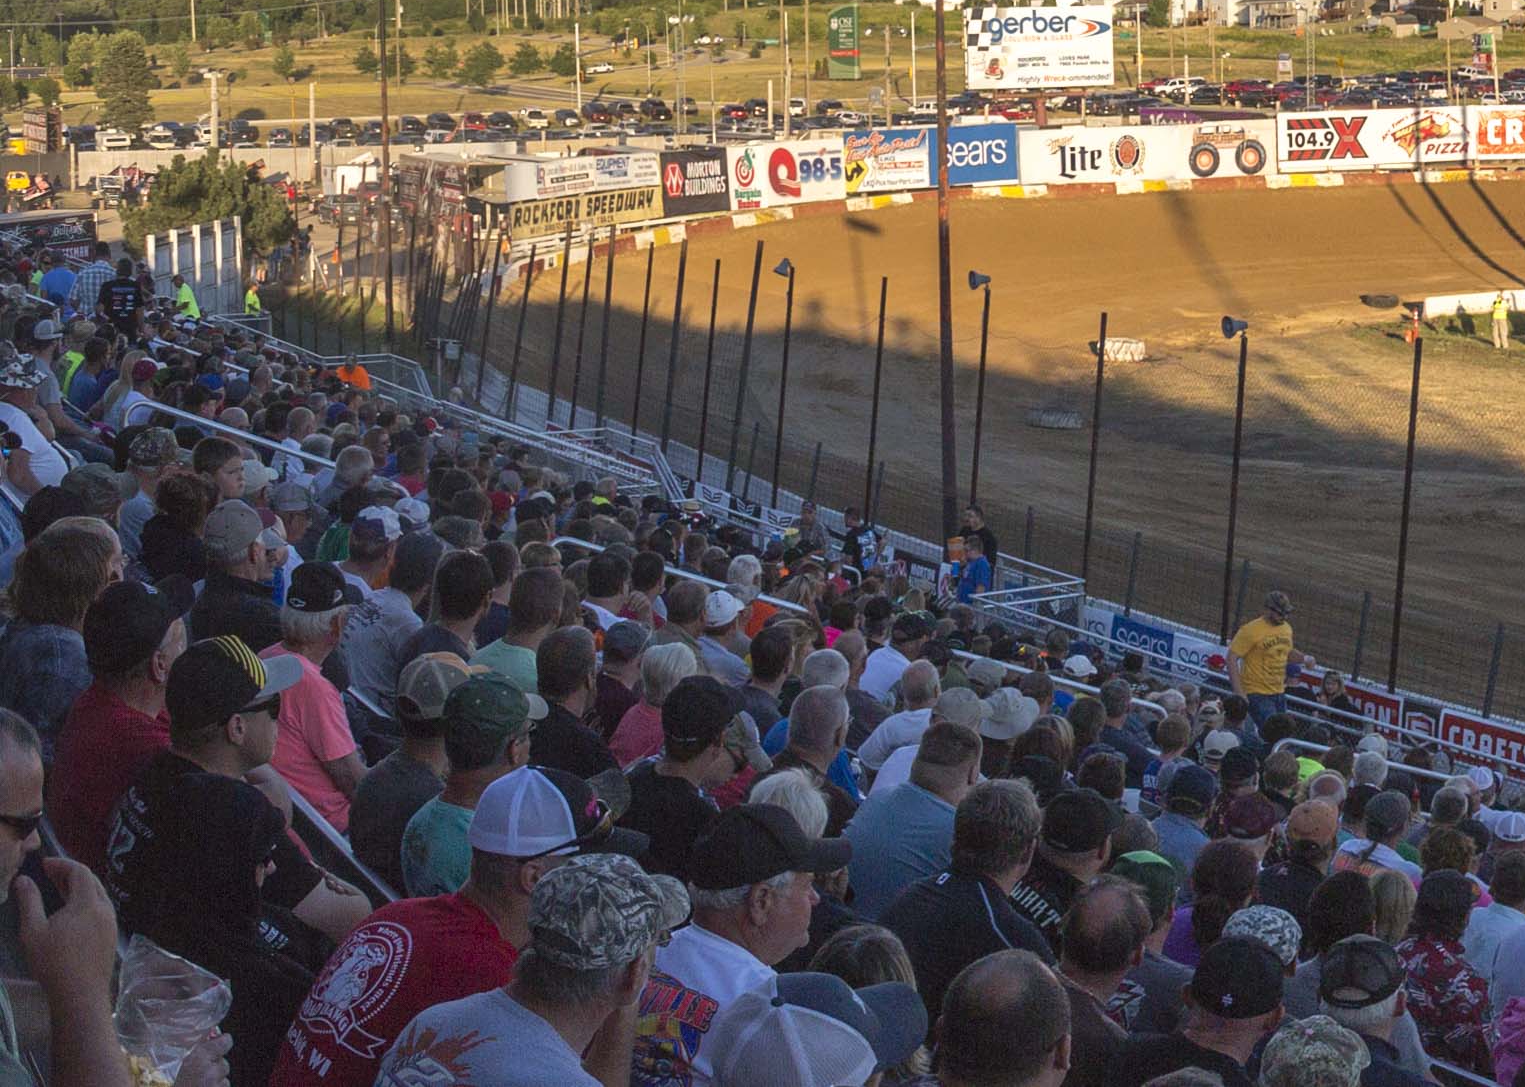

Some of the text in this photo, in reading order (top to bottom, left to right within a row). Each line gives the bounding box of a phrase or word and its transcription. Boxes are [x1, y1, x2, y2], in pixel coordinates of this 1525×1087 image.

[988, 9, 1077, 42] gerber
[1017, 75, 1041, 85] Highly
[1286, 132, 1334, 148] 104.9
[1329, 116, 1369, 159] X
[1425, 141, 1470, 155] PIZZA
[687, 160, 721, 177] MORTON
[1059, 145, 1102, 179] Lite
[684, 176, 726, 197] BUILDINGS
[586, 189, 655, 217] SPEEDWAY
[1115, 627, 1168, 665] sears
